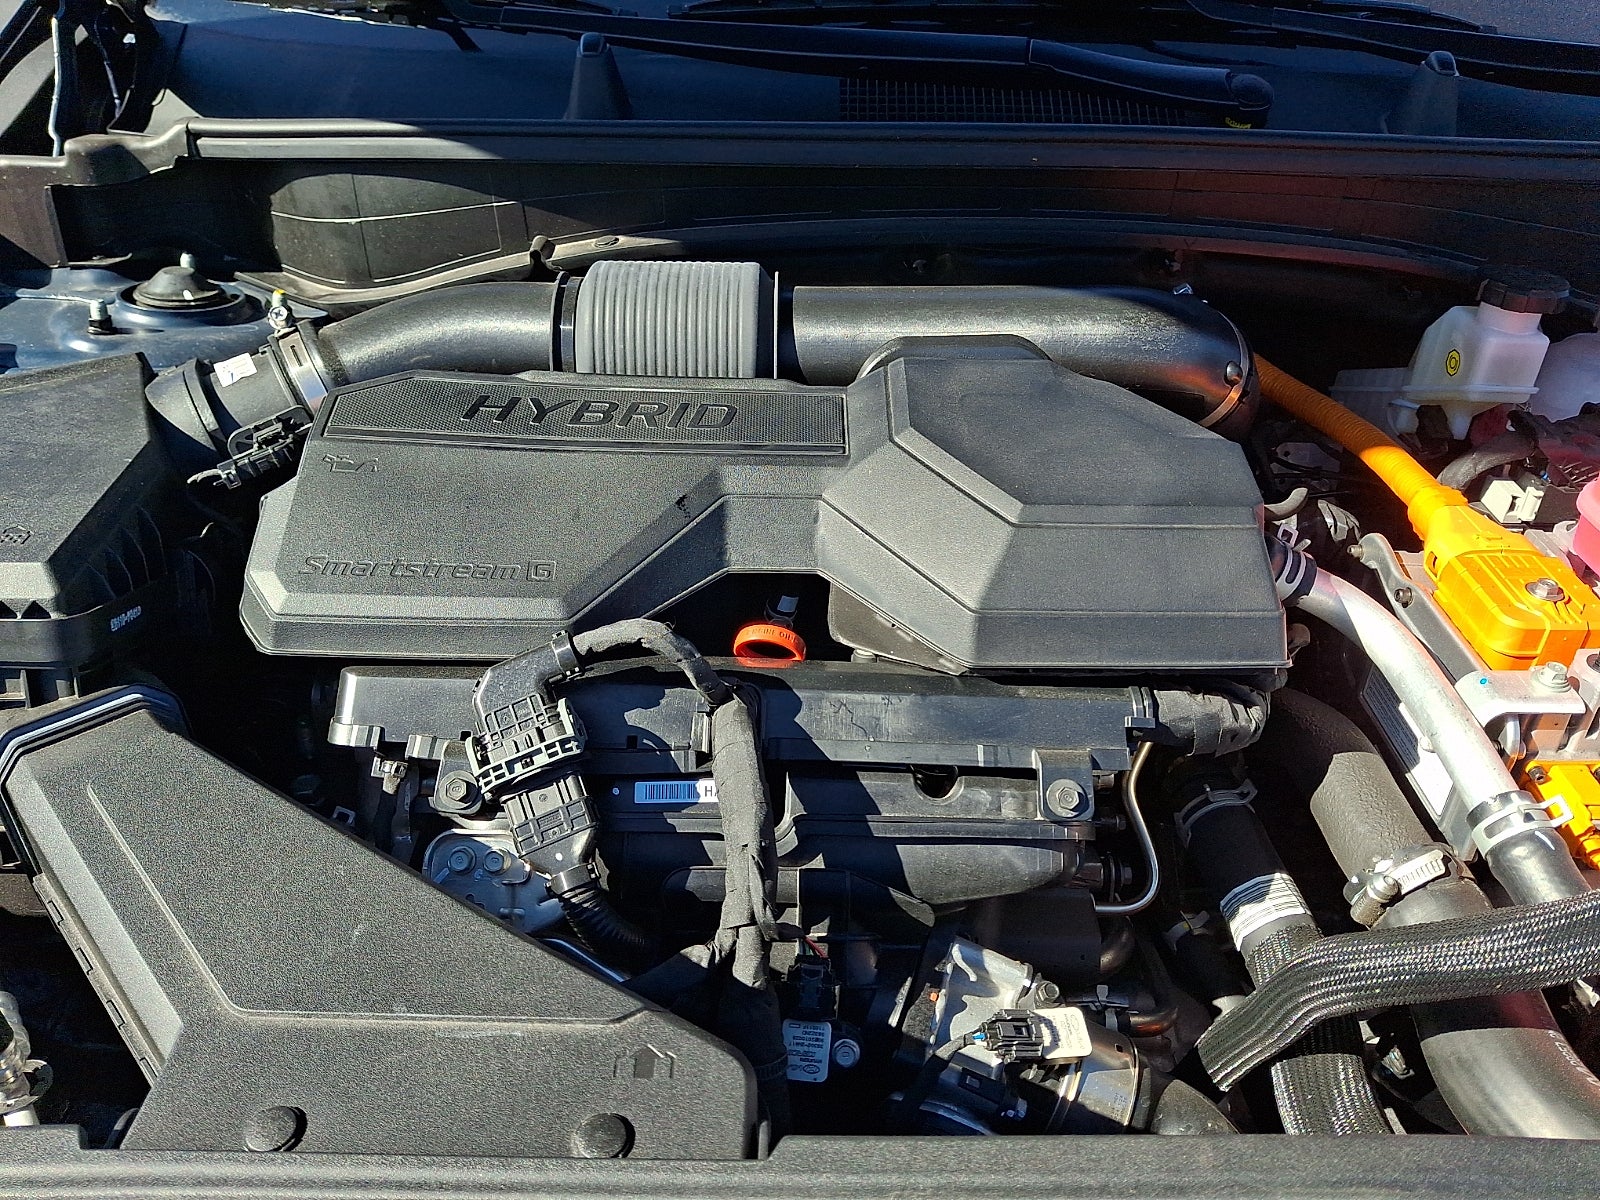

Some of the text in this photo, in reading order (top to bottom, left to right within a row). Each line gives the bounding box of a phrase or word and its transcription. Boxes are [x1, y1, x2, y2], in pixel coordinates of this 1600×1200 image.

[460, 394, 737, 429] HYBRID
[299, 555, 555, 581] Smartstream G
